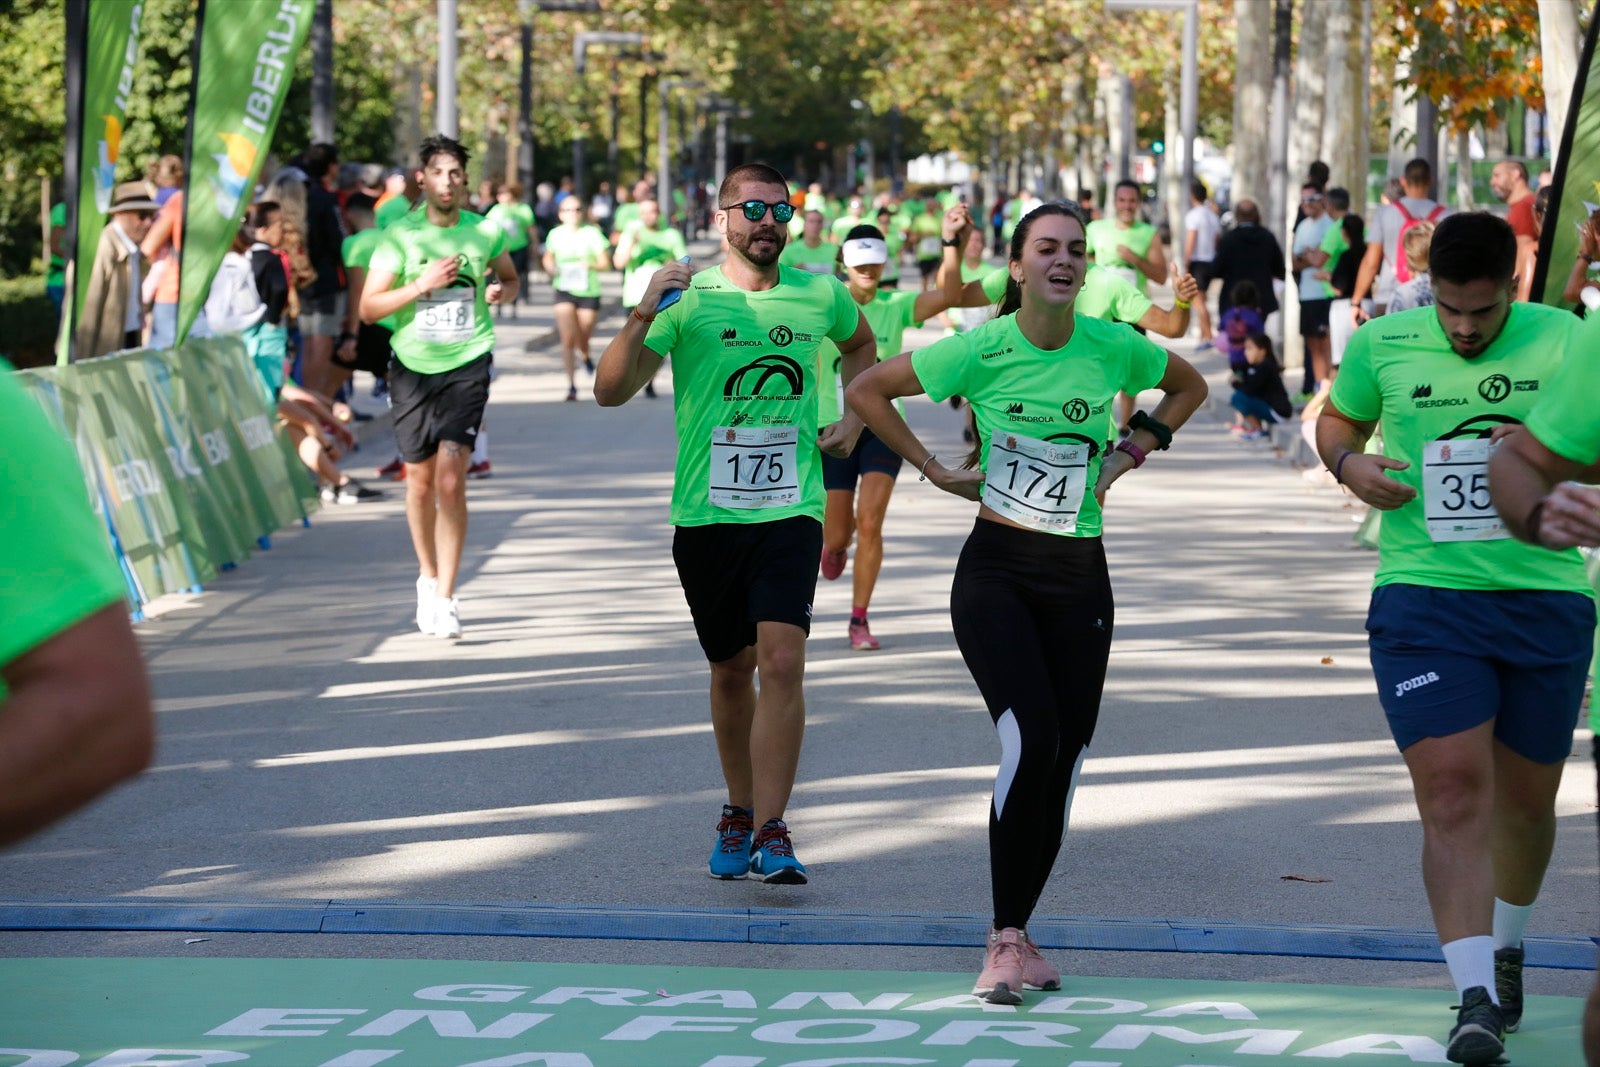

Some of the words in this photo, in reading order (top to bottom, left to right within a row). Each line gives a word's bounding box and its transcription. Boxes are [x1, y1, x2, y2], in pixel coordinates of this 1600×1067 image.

[425, 306, 469, 327] 548
[981, 349, 1005, 360] luanvi
[1415, 398, 1469, 409] IBERDROLA
[1009, 415, 1054, 423] IBERDROLA
[727, 452, 784, 485] 175
[1006, 459, 1068, 507] 174
[413, 983, 1259, 1021] GRANADA
[203, 1008, 555, 1039] EN
[600, 1015, 1453, 1064] FORMA
